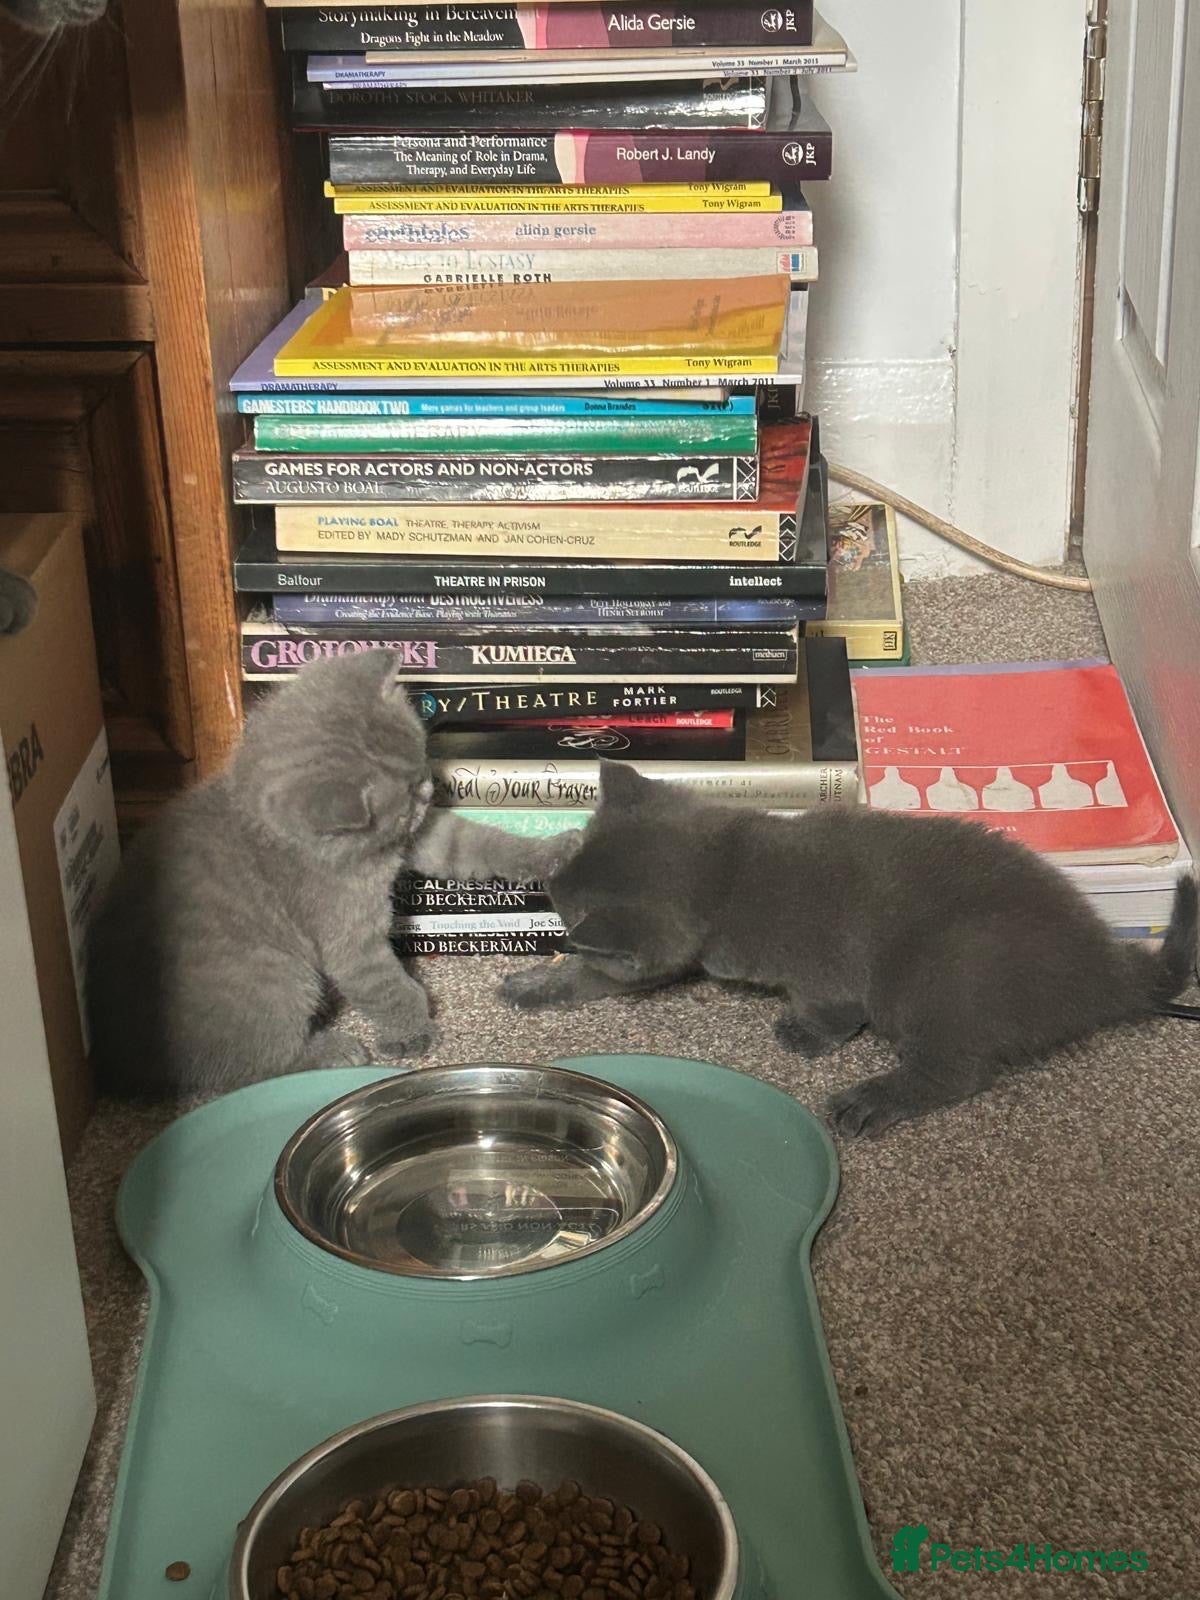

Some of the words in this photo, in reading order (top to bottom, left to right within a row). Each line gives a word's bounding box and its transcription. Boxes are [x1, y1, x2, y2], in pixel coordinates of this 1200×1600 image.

[318, 6, 417, 27] Storymaking
[426, 7, 439, 21] in
[608, 14, 644, 31] Alida
[648, 14, 696, 31] Gersie
[785, 9, 797, 31] JKP
[361, 32, 402, 50] Dragons
[405, 31, 430, 47] Fight
[434, 32, 443, 42] in
[446, 31, 461, 43] the
[463, 31, 505, 43] Meadow
[749, 59, 773, 67] Number
[782, 57, 802, 66] March
[335, 70, 386, 79] DRAMATHERAPY
[330, 90, 399, 104] DOROTHY
[405, 90, 453, 104] STOCK
[457, 90, 535, 103] WHITAKER
[393, 136, 441, 148] Persona
[443, 136, 467, 148] and
[471, 136, 548, 148] Performance
[394, 151, 414, 162] The
[416, 151, 458, 164] Meaning
[461, 151, 472, 162] of
[476, 151, 498, 162] Role
[501, 152, 511, 162] in
[513, 151, 548, 163] Drama,
[617, 148, 658, 161] Robert
[662, 148, 673, 160] J.
[677, 148, 716, 163] Landy
[806, 142, 817, 165] JKP
[406, 165, 448, 178] Therapy,
[450, 165, 468, 175] and
[470, 165, 514, 177] Everyday
[517, 164, 536, 175] Life
[355, 185, 417, 193] ASSESSMENT
[420, 185, 444, 193] AND
[446, 185, 507, 193] EVALUATION
[689, 183, 708, 192] Tony
[711, 182, 746, 193] Wigram
[369, 202, 433, 210] ASSESSMENT
[436, 202, 458, 210] AND
[460, 203, 527, 211] EVALUATION
[528, 203, 540, 211] IN
[542, 203, 561, 211] THE
[564, 204, 589, 212] ARTS
[591, 204, 645, 212] THERAPIES
[703, 199, 726, 209] Tony
[727, 199, 761, 210] Wigram
[515, 224, 550, 236] alida
[554, 223, 597, 238] gersie
[423, 274, 504, 284] GABRIELLE
[513, 273, 552, 283] ROTH
[312, 361, 383, 371] ASSESSMENT
[386, 361, 411, 371] AND
[414, 362, 486, 372] EVALUATION
[489, 362, 501, 372] IN
[504, 363, 526, 373] THE
[529, 363, 558, 373] ARTS
[560, 363, 620, 373] THERAPIES
[686, 358, 711, 369] Tony
[713, 357, 752, 368] Wigram
[261, 383, 338, 392] DRAMATHERAPY
[603, 379, 640, 388] Volume
[662, 378, 703, 387] Number
[718, 377, 749, 386] March
[317, 400, 380, 415] HANDBOOK
[381, 401, 409, 415] TWO
[584, 402, 606, 411] Donna
[607, 402, 636, 411] Brandes
[265, 463, 323, 476] GAMES
[327, 463, 361, 476] FOR
[364, 462, 434, 476] ACTORS
[437, 462, 475, 476] AND
[479, 462, 593, 476] NON-ACTORS
[265, 481, 339, 494] AUGUSTO
[343, 481, 383, 495] BOAL
[679, 484, 719, 493] ROUTLEDGE
[317, 517, 367, 527] PLAYING
[369, 517, 399, 527] BOAL
[497, 520, 541, 530] ACTIVISM
[318, 531, 356, 541] EDITED
[358, 531, 371, 541] BY
[376, 531, 406, 542] MADY
[408, 532, 472, 543] SCHUTZMAN
[477, 534, 499, 544] AND
[504, 534, 524, 544] JAN
[526, 535, 596, 545] COHEN-CRUZ
[277, 574, 323, 586] Balfour
[434, 575, 485, 587] THEATRE
[488, 576, 500, 587] IN
[503, 576, 546, 587] PRISON
[729, 576, 782, 587] intellect
[471, 645, 576, 665] KUMIEGA
[421, 690, 597, 714] RY/THEATRE
[623, 685, 665, 696] MARK
[613, 696, 677, 708] FORTIER
[676, 718, 712, 726] ROUTLEDGE
[861, 715, 895, 723] The
[908, 725, 954, 733] Book
[865, 746, 964, 755] GESTALT
[426, 894, 525, 906] BECKERMAN
[431, 920, 477, 932] Touching
[479, 919, 495, 930] the
[499, 918, 520, 929] Void
[529, 918, 546, 930] Joe
[439, 941, 537, 953] BECKERMAN
